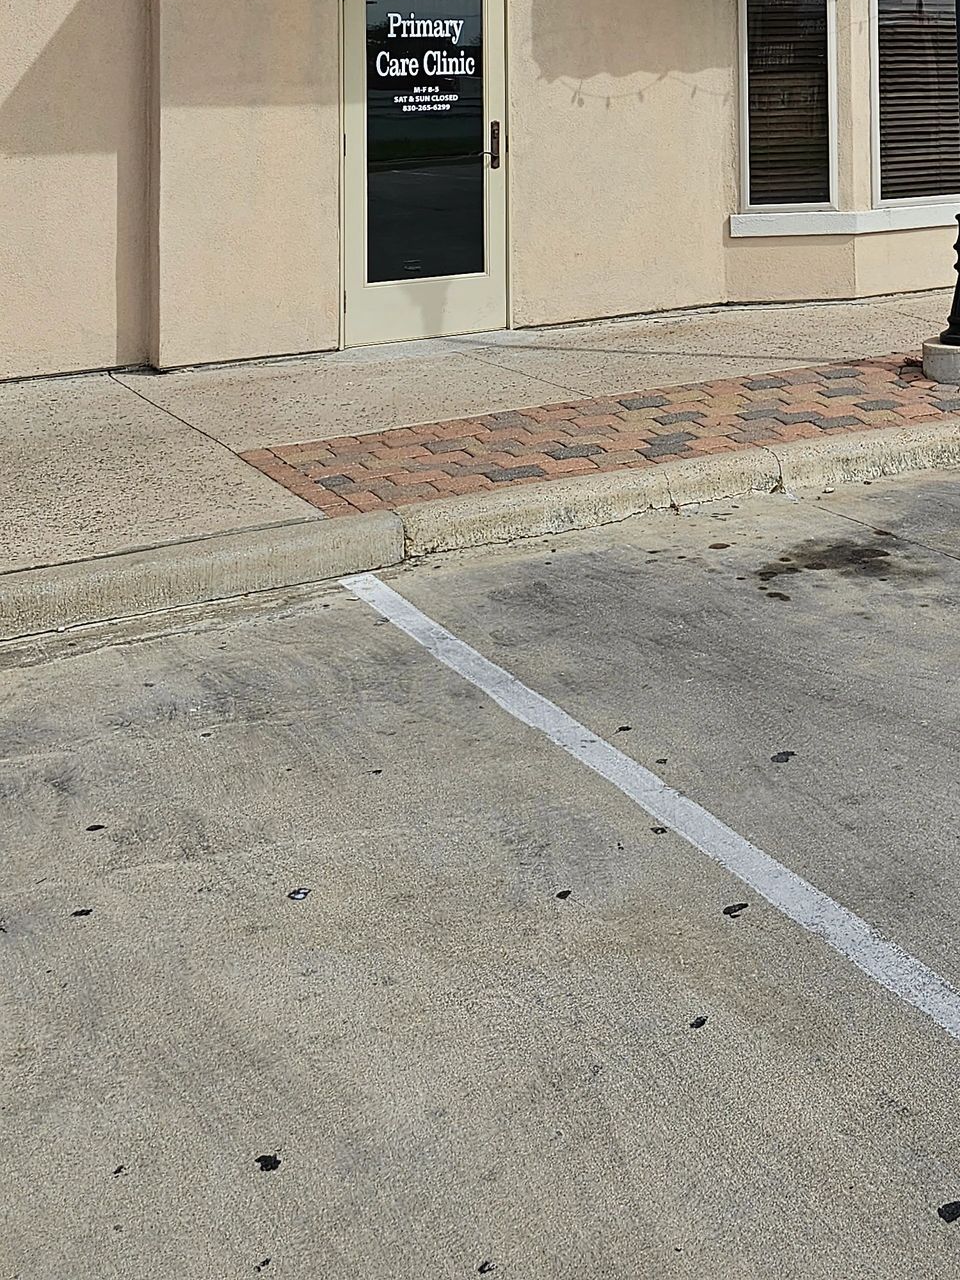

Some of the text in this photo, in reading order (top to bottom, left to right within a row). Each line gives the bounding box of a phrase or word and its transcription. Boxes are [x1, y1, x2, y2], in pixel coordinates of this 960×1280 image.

[387, 12, 464, 44] Primary
[375, 50, 476, 77] Care Clinic
[431, 94, 459, 102] CLOSED
